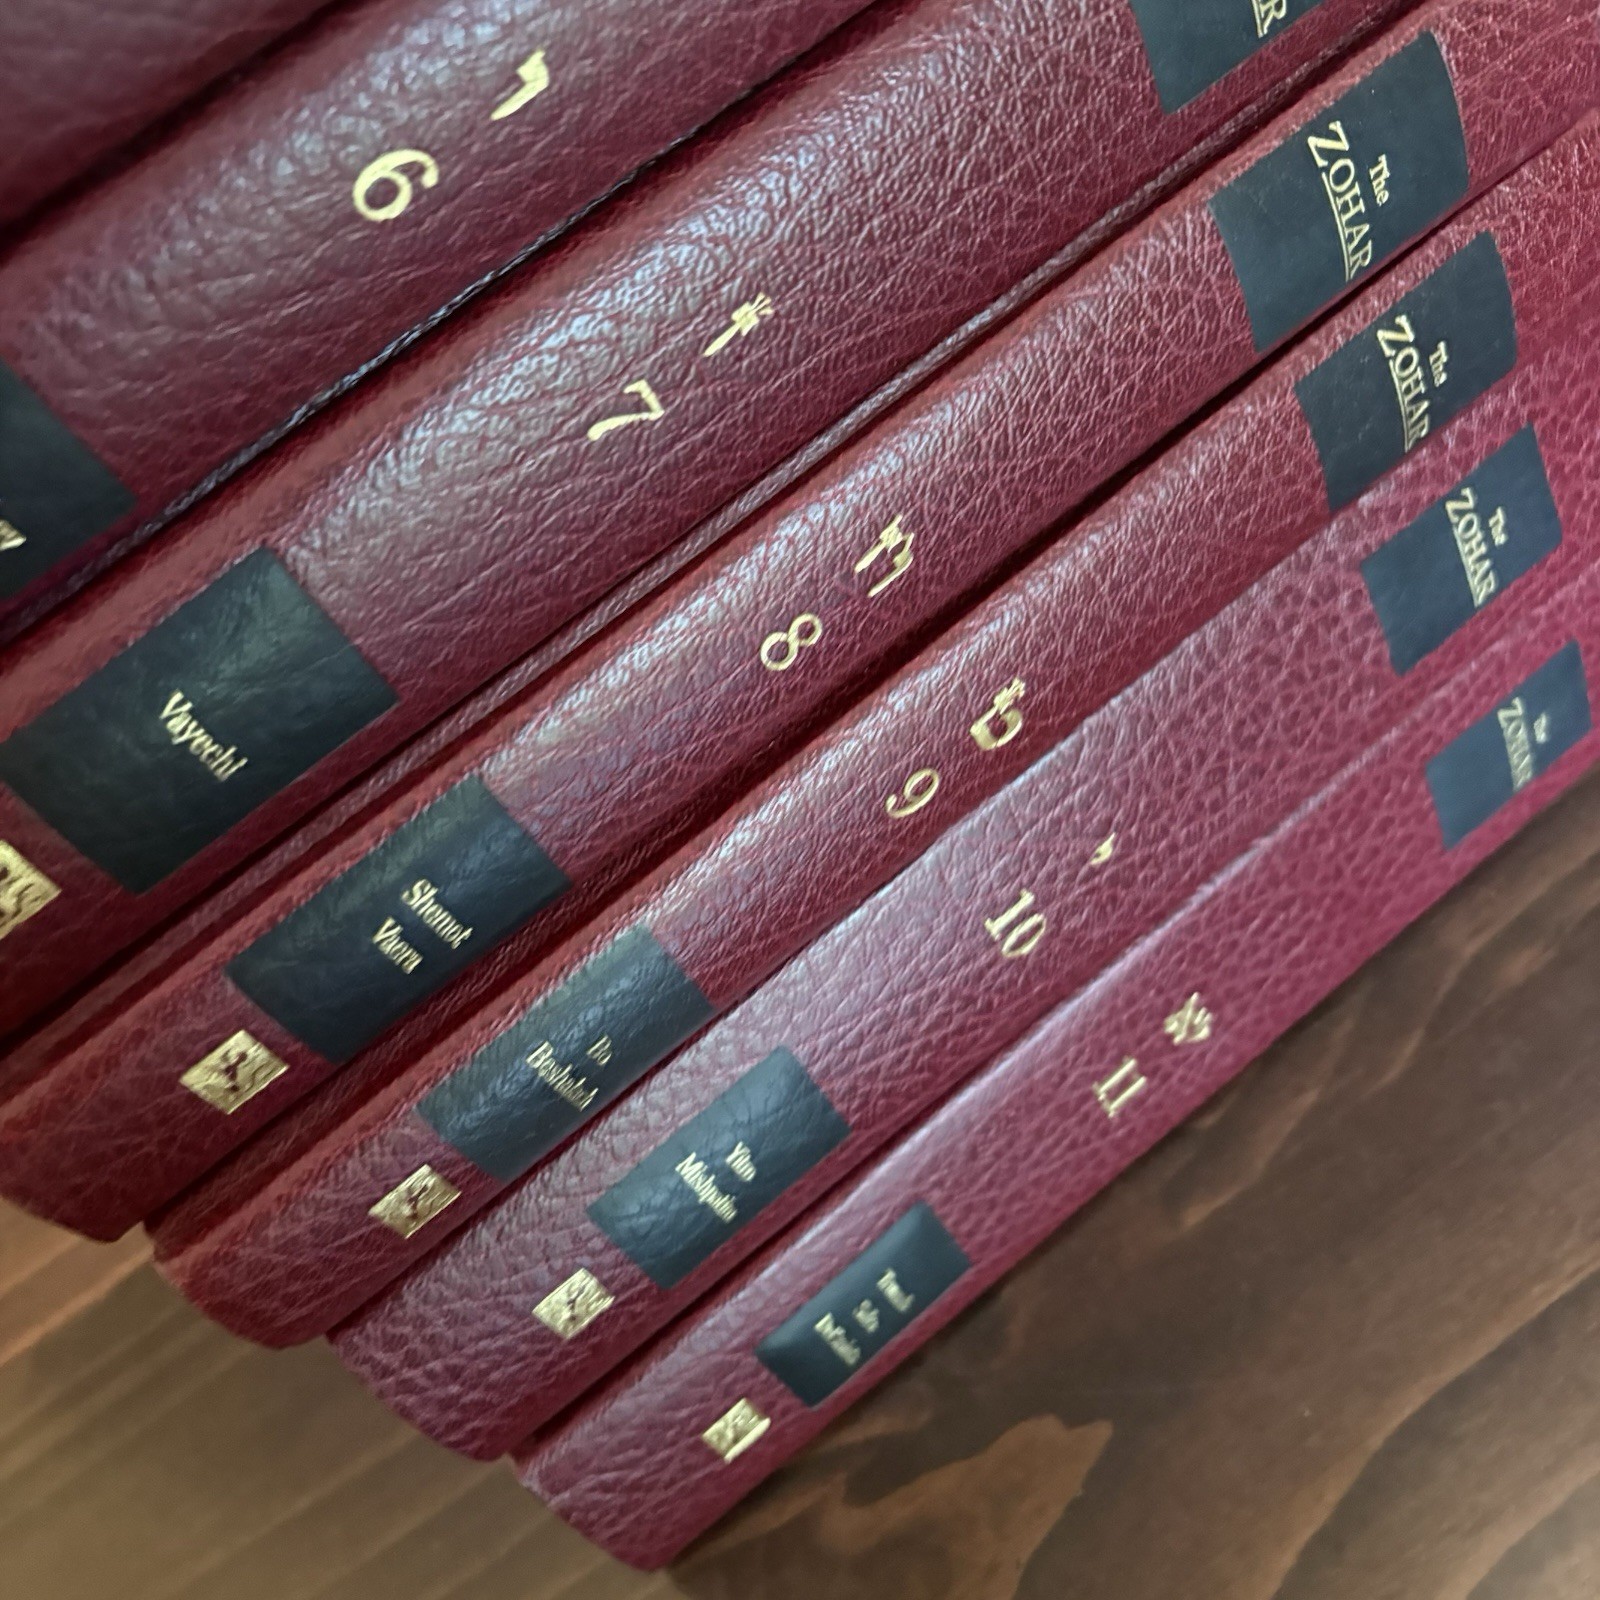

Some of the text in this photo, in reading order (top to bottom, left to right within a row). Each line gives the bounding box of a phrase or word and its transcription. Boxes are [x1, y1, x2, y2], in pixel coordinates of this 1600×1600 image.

[352, 149, 440, 222] 6
[1307, 120, 1373, 283] ZOHAR
[1369, 154, 1390, 206] The
[1376, 314, 1430, 453] ZOHAR
[1429, 341, 1449, 387] The
[587, 379, 665, 442] 7
[1445, 487, 1495, 607] ZOHAR
[1488, 506, 1508, 546] The
[760, 612, 823, 671] 8
[159, 690, 249, 782] Vayechi
[885, 768, 940, 819] 9
[372, 915, 424, 975] Vaera
[401, 878, 474, 950] Shemot
[984, 888, 1047, 957] 10
[586, 1034, 613, 1067] Bo
[1092, 1055, 1147, 1119] 11
